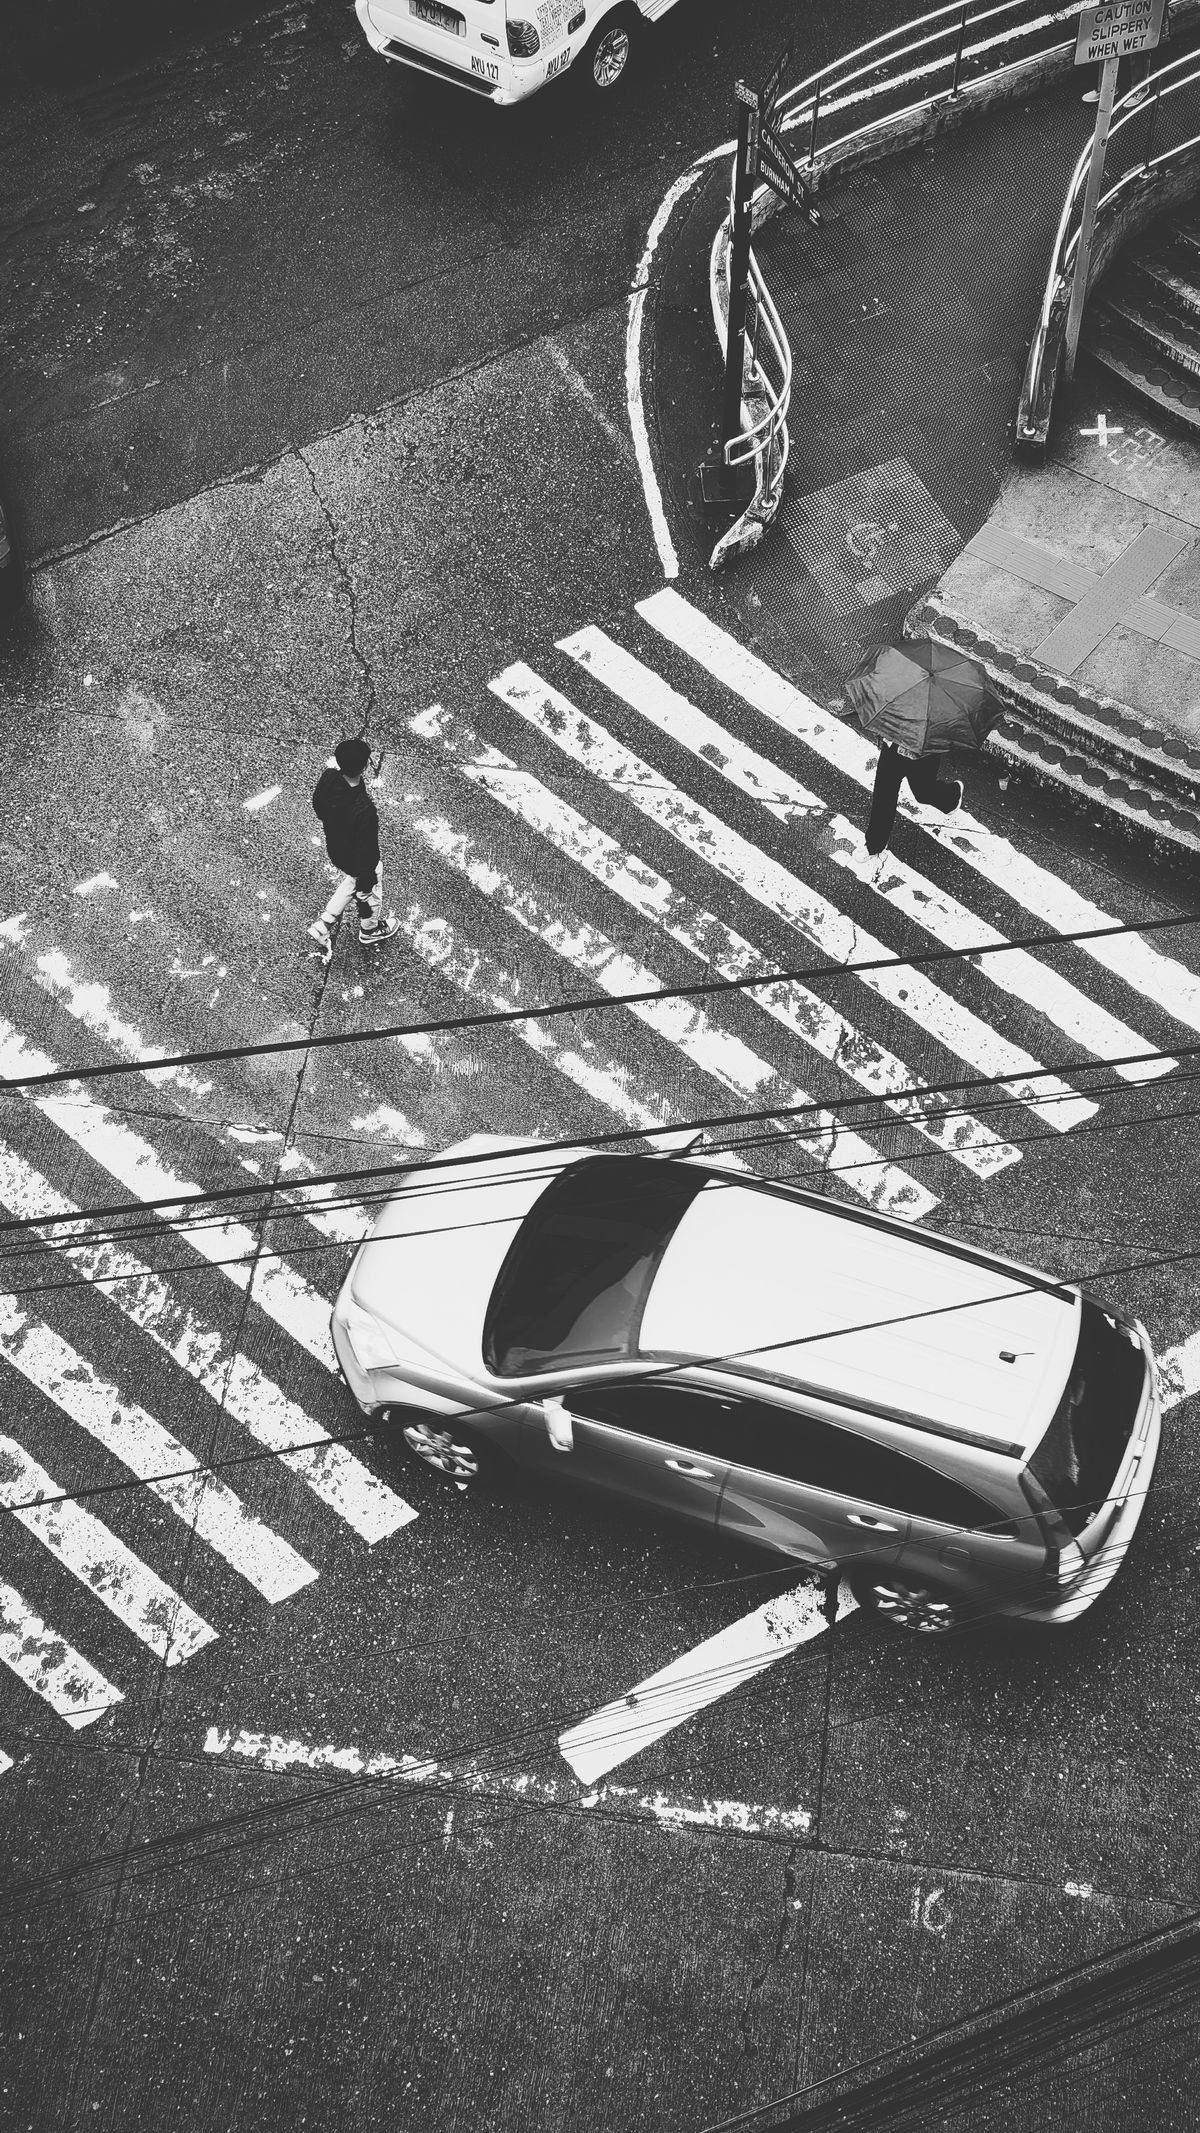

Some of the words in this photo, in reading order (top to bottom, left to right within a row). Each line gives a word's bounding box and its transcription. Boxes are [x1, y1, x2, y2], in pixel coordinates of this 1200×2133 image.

[1095, 0, 1152, 23] CAUTION
[1091, 17, 1152, 41] SLIPPERY
[1088, 41, 1118, 59] WHEN
[1123, 34, 1147, 51] WET
[471, 55, 485, 74] AYU
[486, 62, 499, 80] 127
[545, 55, 560, 78] AYU
[560, 46, 571, 68] 127
[761, 129, 794, 184] CALDERON
[760, 160, 790, 196] BURNHAM
